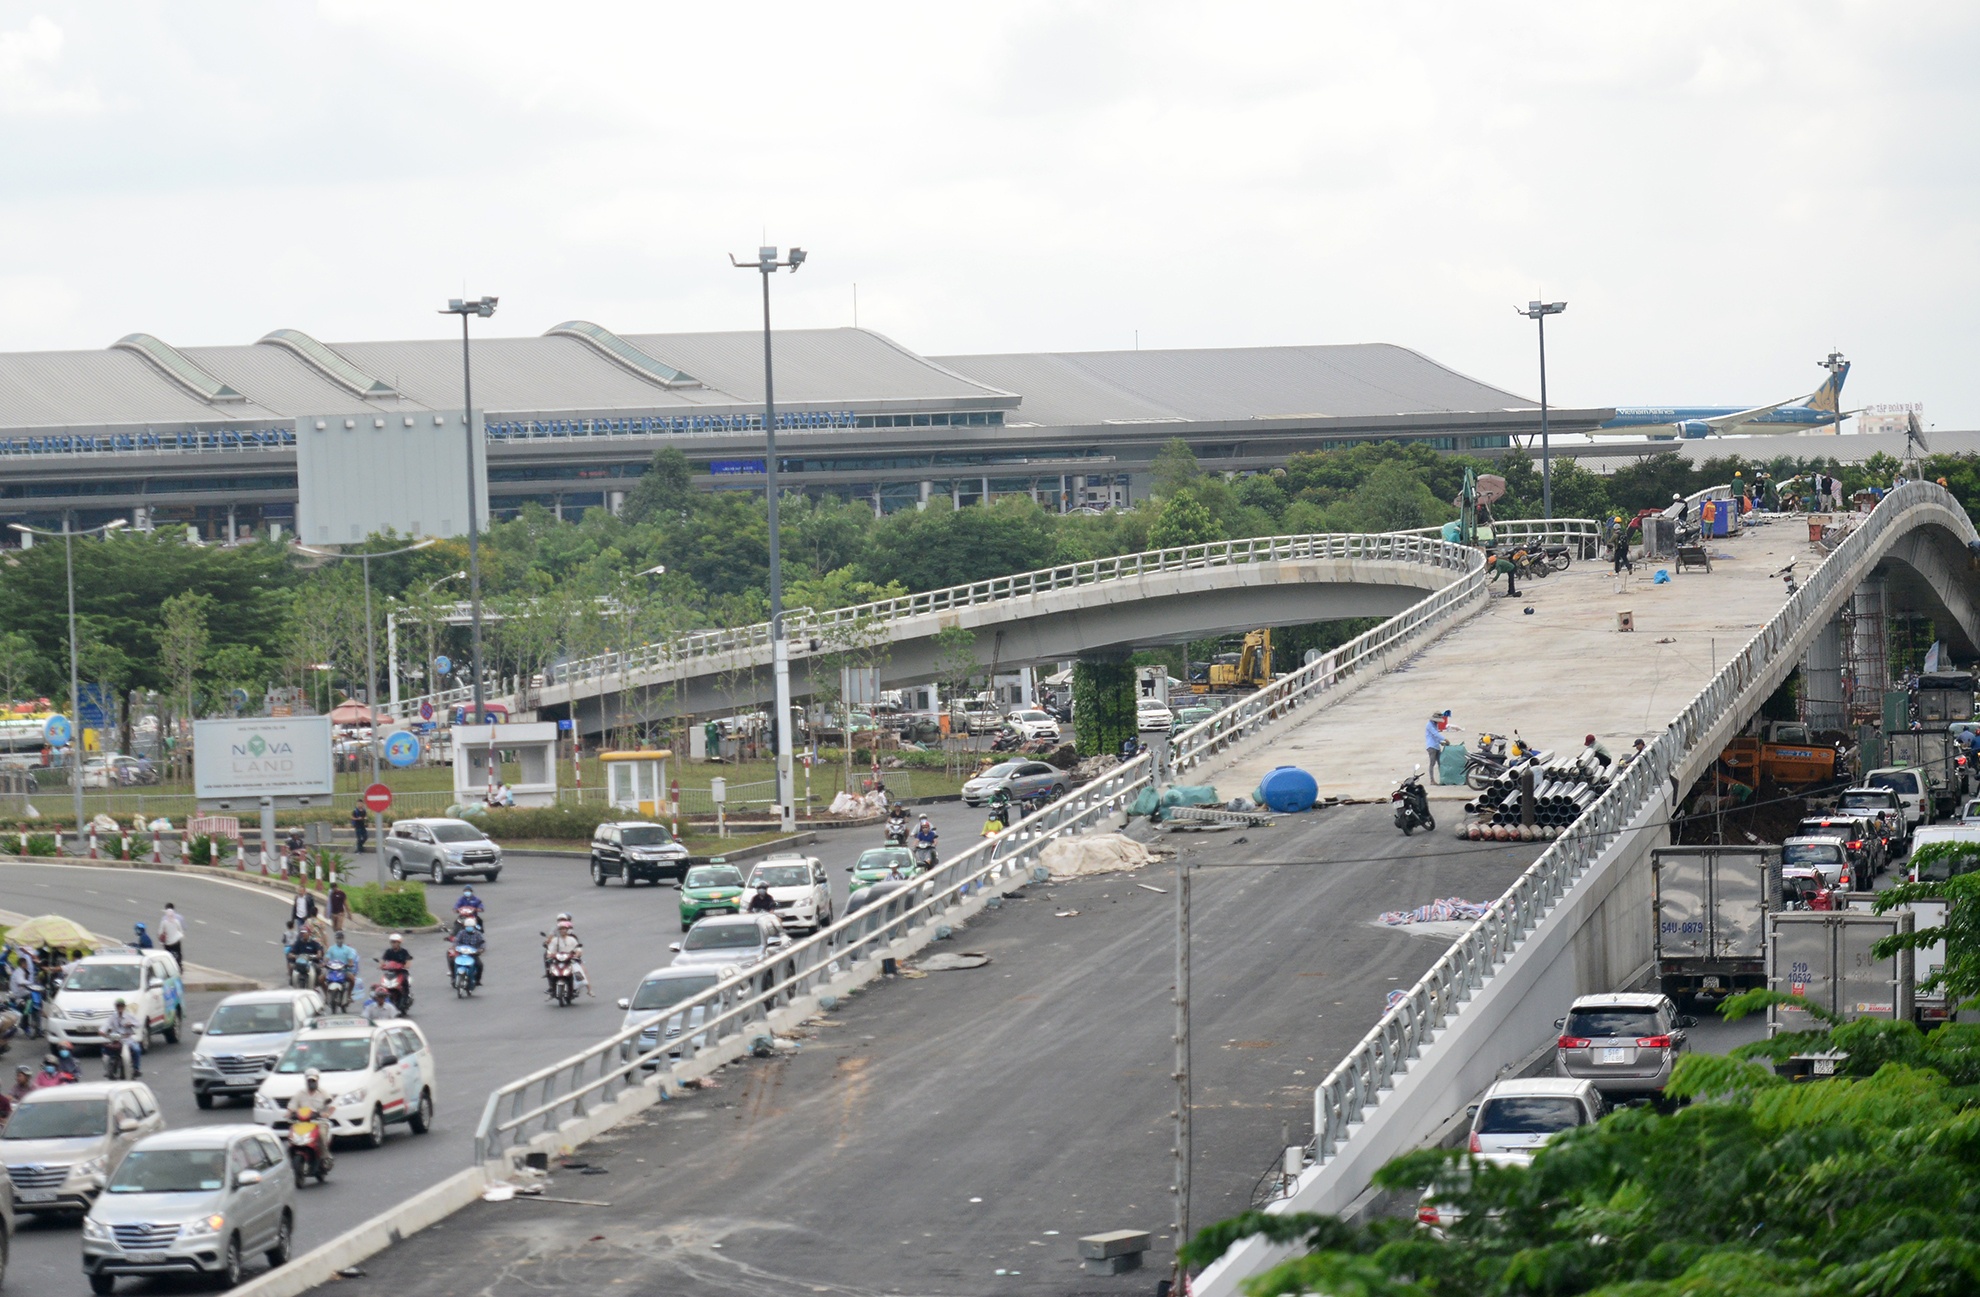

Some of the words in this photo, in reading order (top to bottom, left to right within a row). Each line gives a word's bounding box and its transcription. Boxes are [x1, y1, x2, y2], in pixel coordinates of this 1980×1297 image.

[231, 760, 294, 773] LAND
[1661, 922, 1703, 933] 54U-0879
[1792, 962, 1808, 972] 51D
[1788, 973, 1812, 983] 10532
